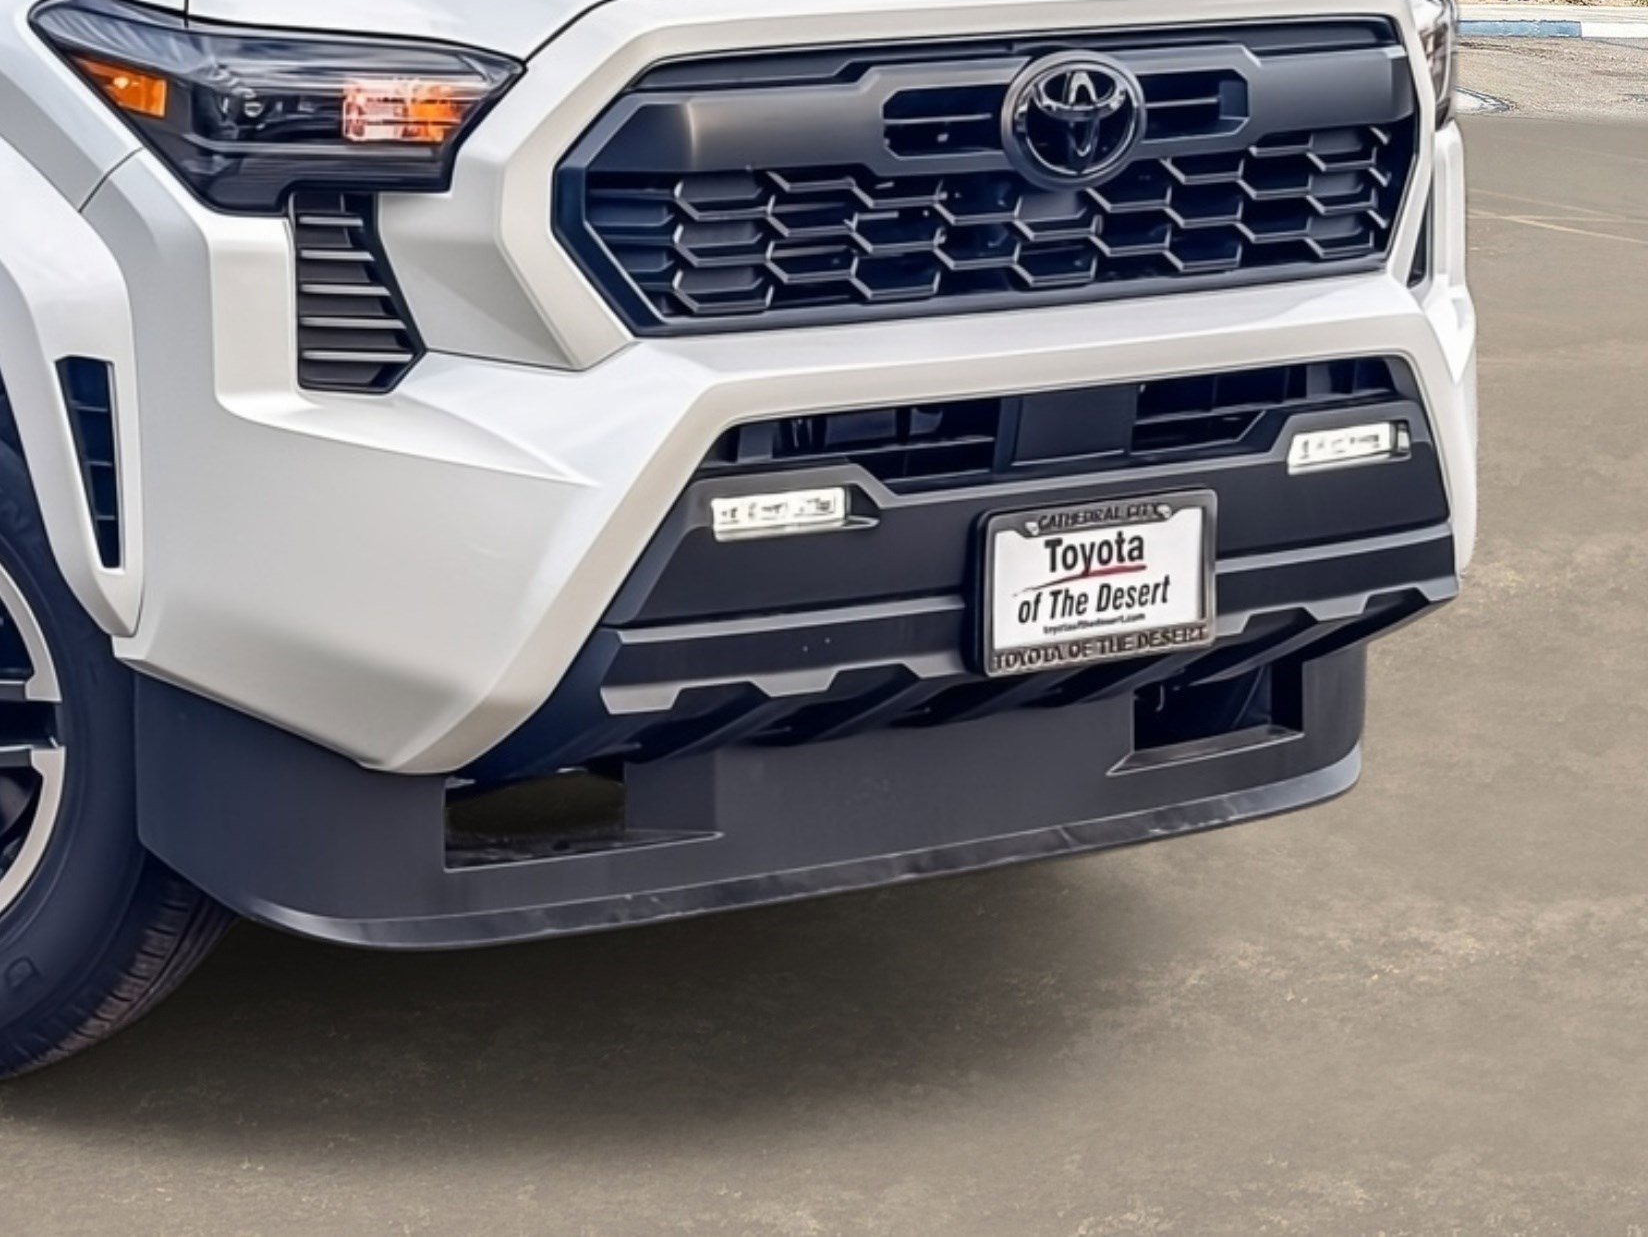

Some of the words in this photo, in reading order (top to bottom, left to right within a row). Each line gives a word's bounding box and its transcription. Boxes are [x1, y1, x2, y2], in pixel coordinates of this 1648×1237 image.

[1044, 531, 1145, 574] Toyota
[1018, 592, 1042, 623] of
[1050, 588, 1089, 620] The
[1096, 575, 1170, 612] Desert
[994, 646, 1063, 669] TOYOTA
[1069, 642, 1094, 658] OF
[1101, 636, 1134, 654] THE
[1138, 625, 1207, 647] DESERT
